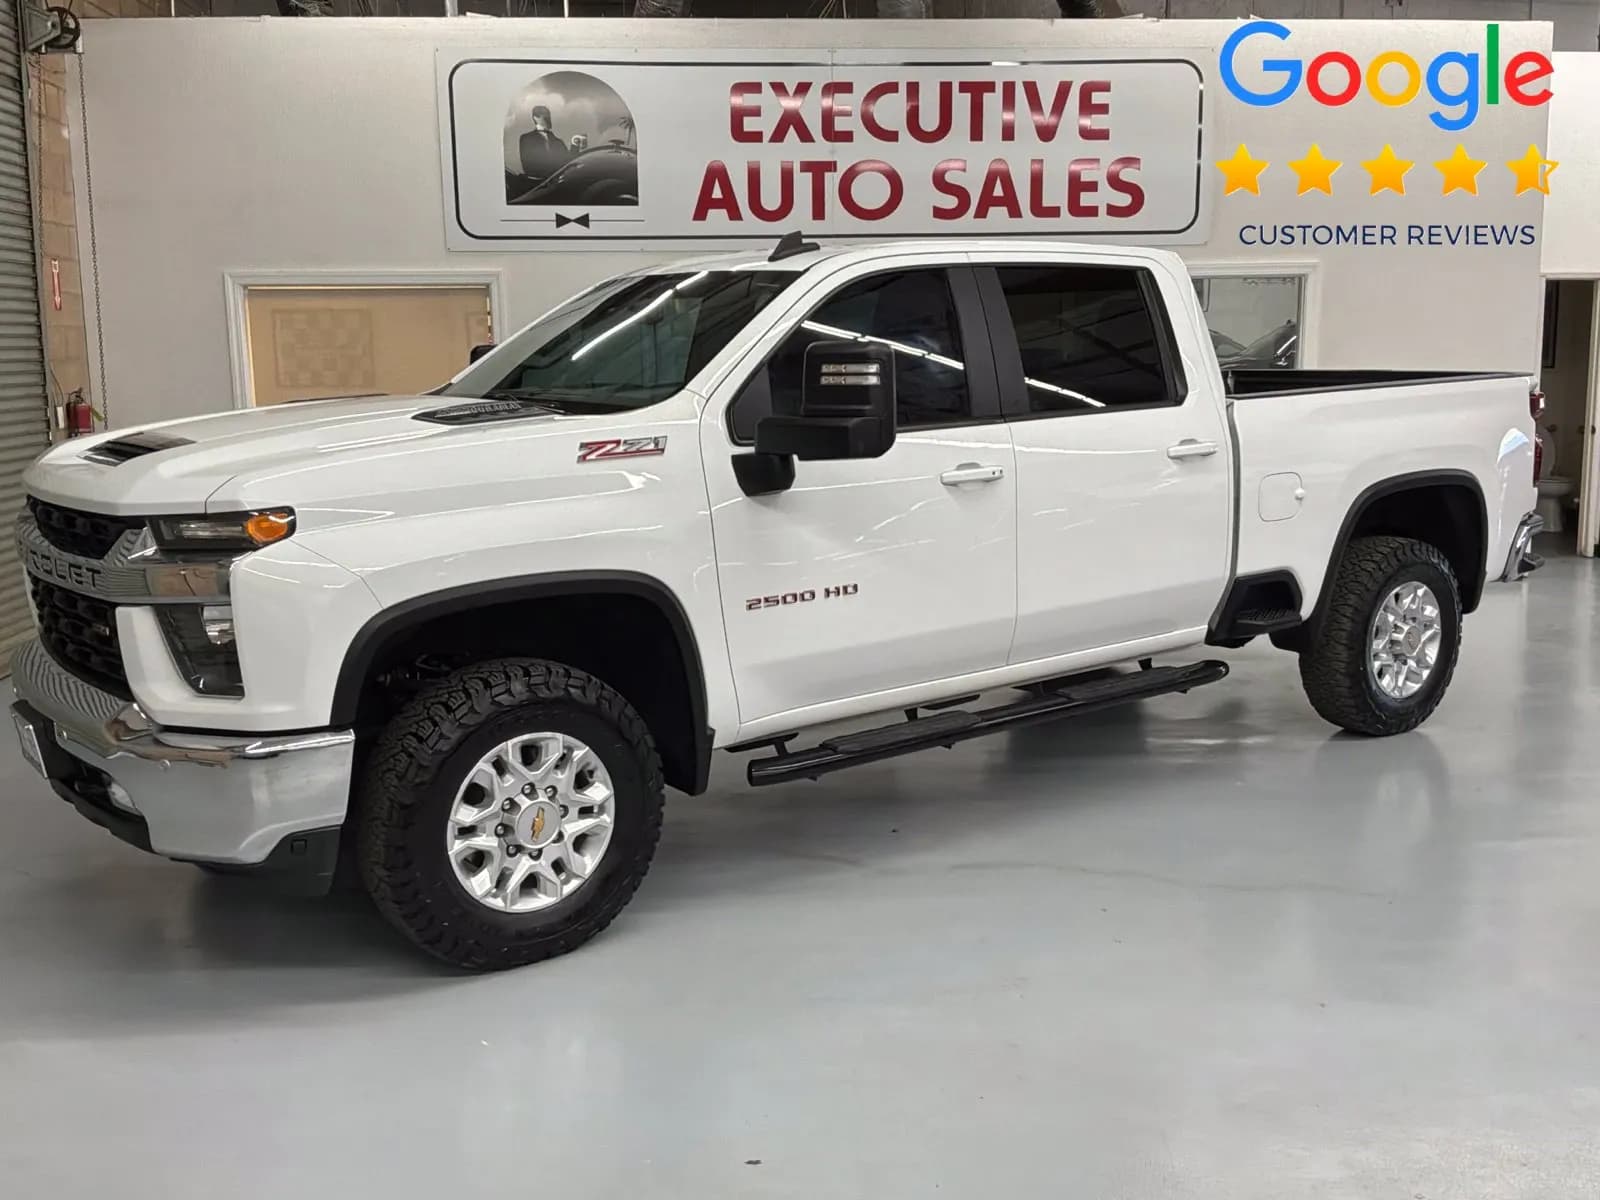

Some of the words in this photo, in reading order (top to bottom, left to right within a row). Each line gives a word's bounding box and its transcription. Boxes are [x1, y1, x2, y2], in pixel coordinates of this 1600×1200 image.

[730, 79, 1111, 144] EXECUTIVE
[692, 160, 904, 223] AUTO
[931, 156, 1145, 221] SALES
[745, 589, 816, 612] 2500
[823, 583, 859, 600] HD
